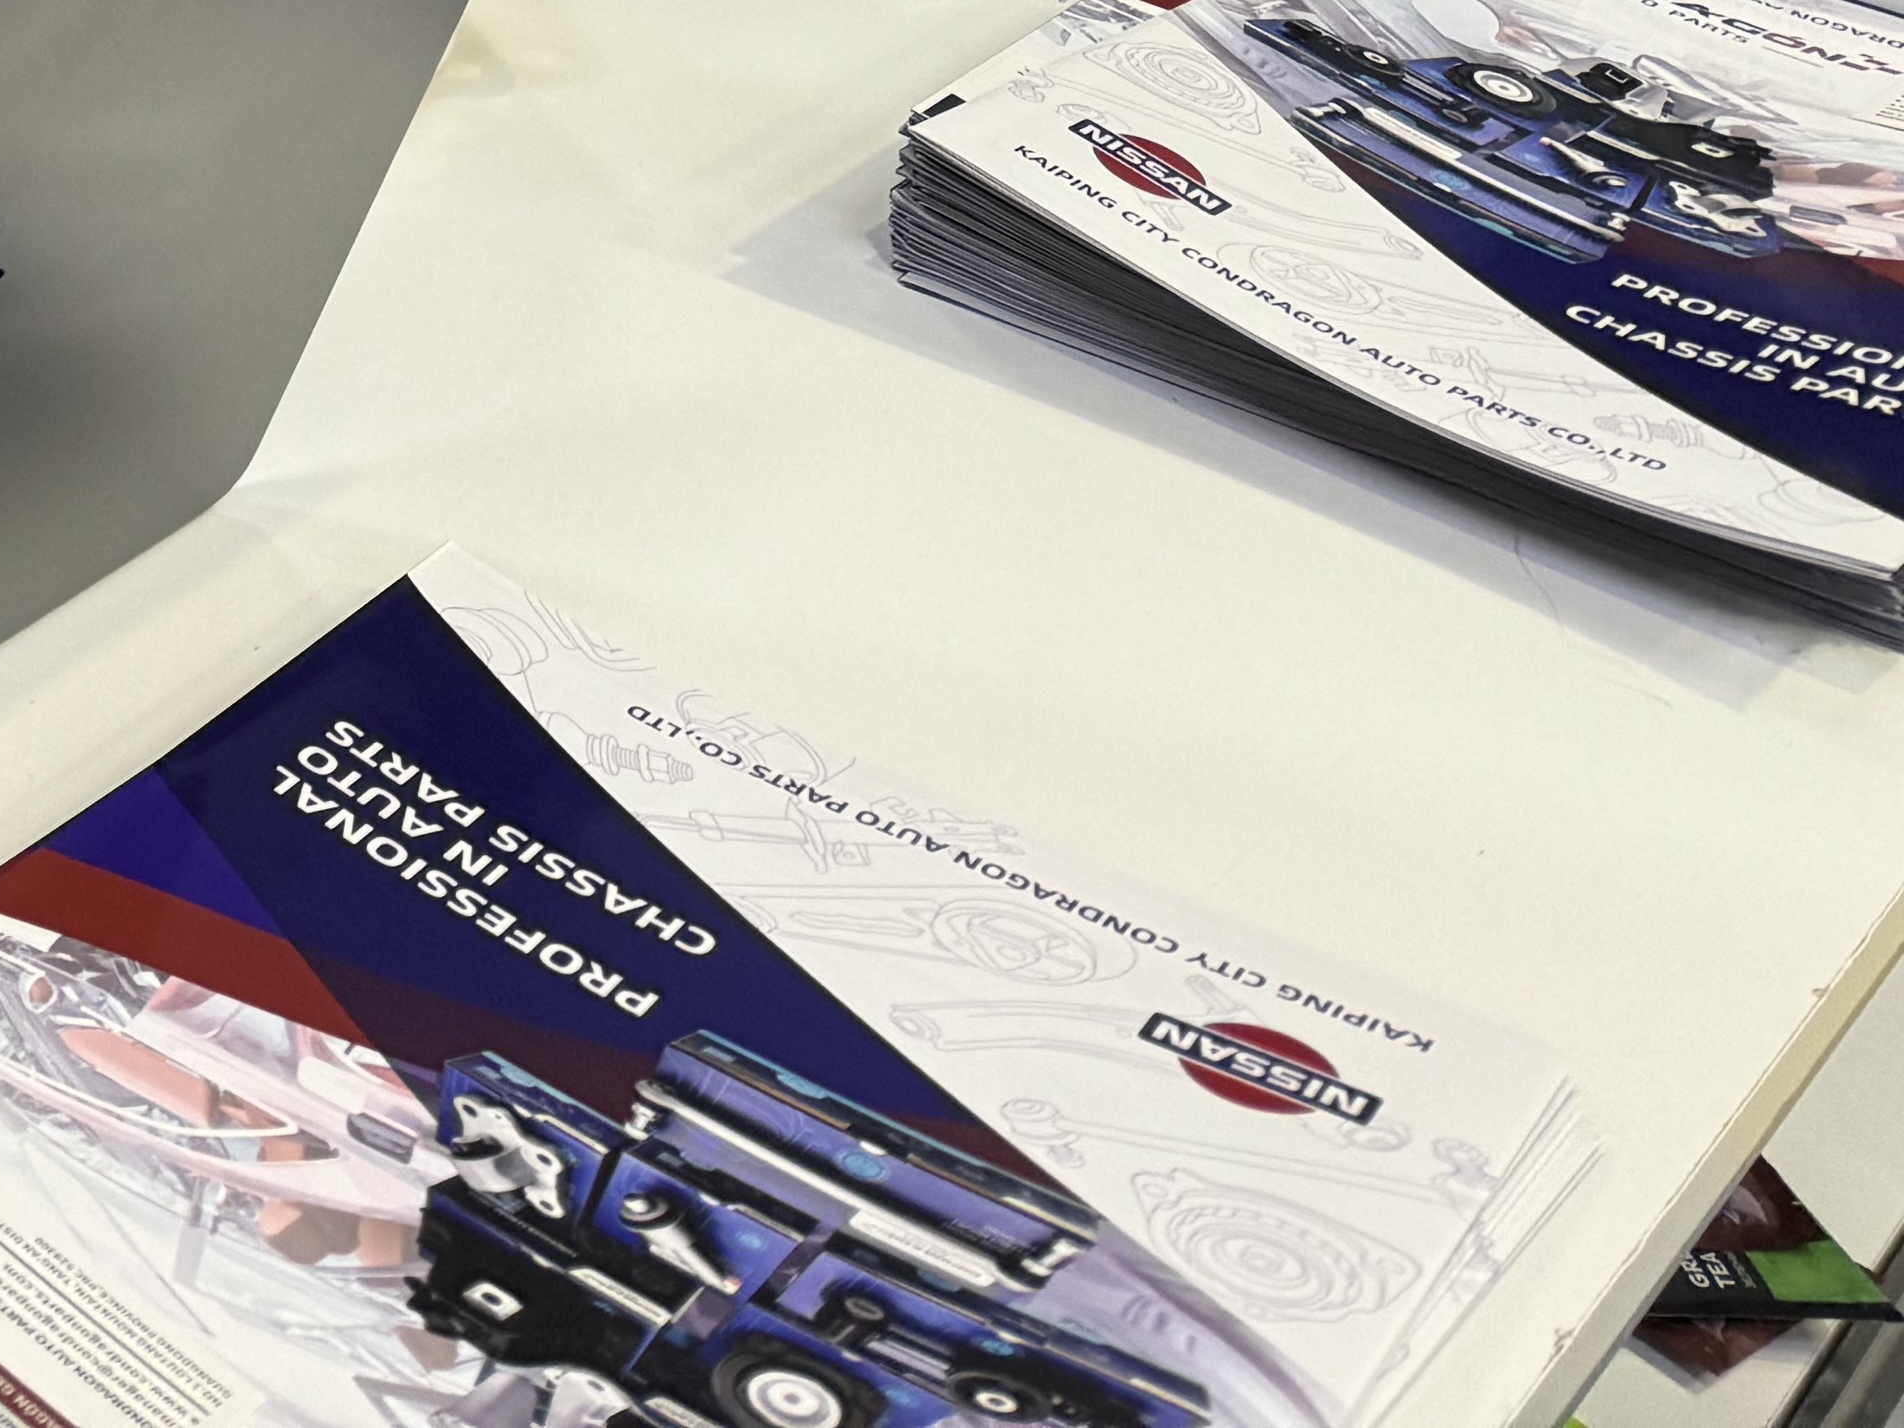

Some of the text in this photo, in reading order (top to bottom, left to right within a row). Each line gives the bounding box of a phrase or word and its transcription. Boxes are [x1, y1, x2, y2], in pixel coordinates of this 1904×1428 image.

[1668, 8, 1750, 44] PARTS
[1078, 123, 1224, 212] NISSAN
[1014, 144, 1118, 209] KAIPING
[1121, 210, 1181, 244] CITY
[1181, 246, 1357, 346] CONDRAGON
[1359, 346, 1442, 386] AUTO
[1446, 385, 1543, 429] PARTS
[1565, 305, 1782, 382] CHASSIS
[1757, 343, 1821, 370] IN
[297, 744, 510, 886] IN AUTO
[747, 763, 850, 814] PARTS
[325, 719, 717, 956] CHASSIS PARTS
[854, 809, 950, 854] AUTO
[272, 764, 661, 1018] PROFESSIONAL
[953, 849, 1180, 955] CONDRAGON
[1186, 951, 1268, 989] CITY
[1276, 982, 1437, 1054] KAIPING
[1149, 1018, 1370, 1118] NISSAN
[1700, 1251, 1737, 1289] TEA
[35, 1333, 76, 1368] AUTO
